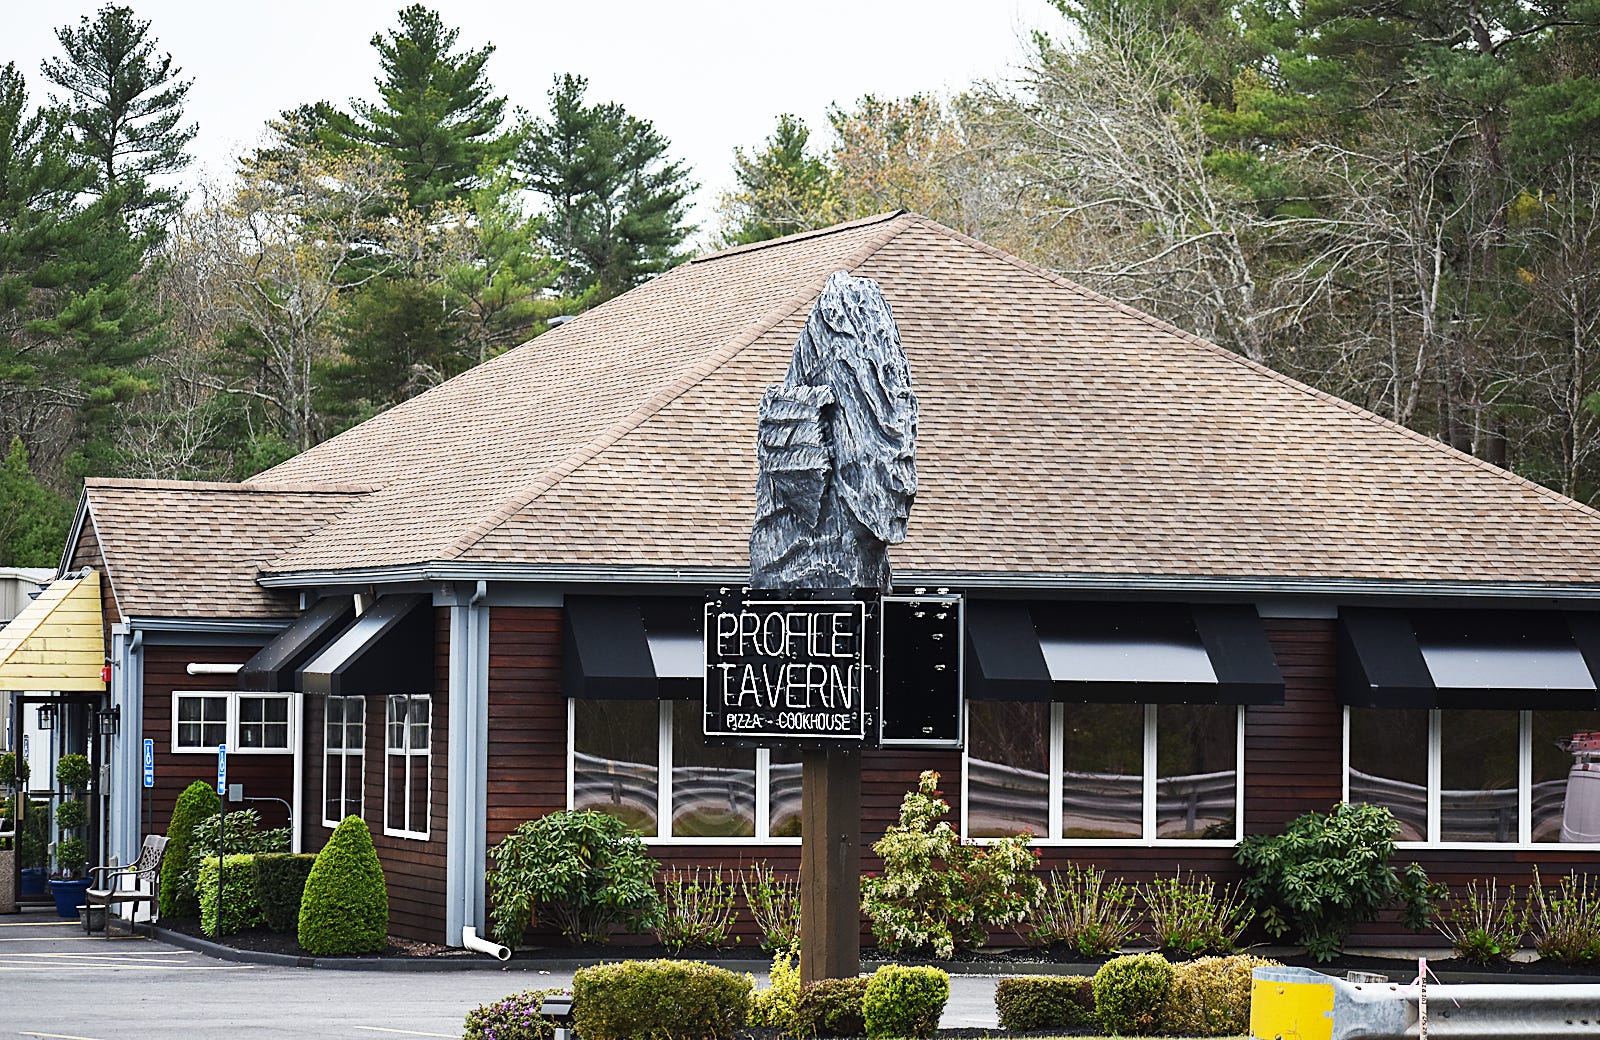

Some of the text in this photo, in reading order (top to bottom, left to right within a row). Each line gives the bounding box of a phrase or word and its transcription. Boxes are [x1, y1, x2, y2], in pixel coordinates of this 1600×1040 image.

[718, 612, 853, 657] PROFILE
[717, 663, 853, 709] TAVERN
[726, 713, 762, 729] PIZZA
[779, 711, 851, 731] COOKHOUSE
